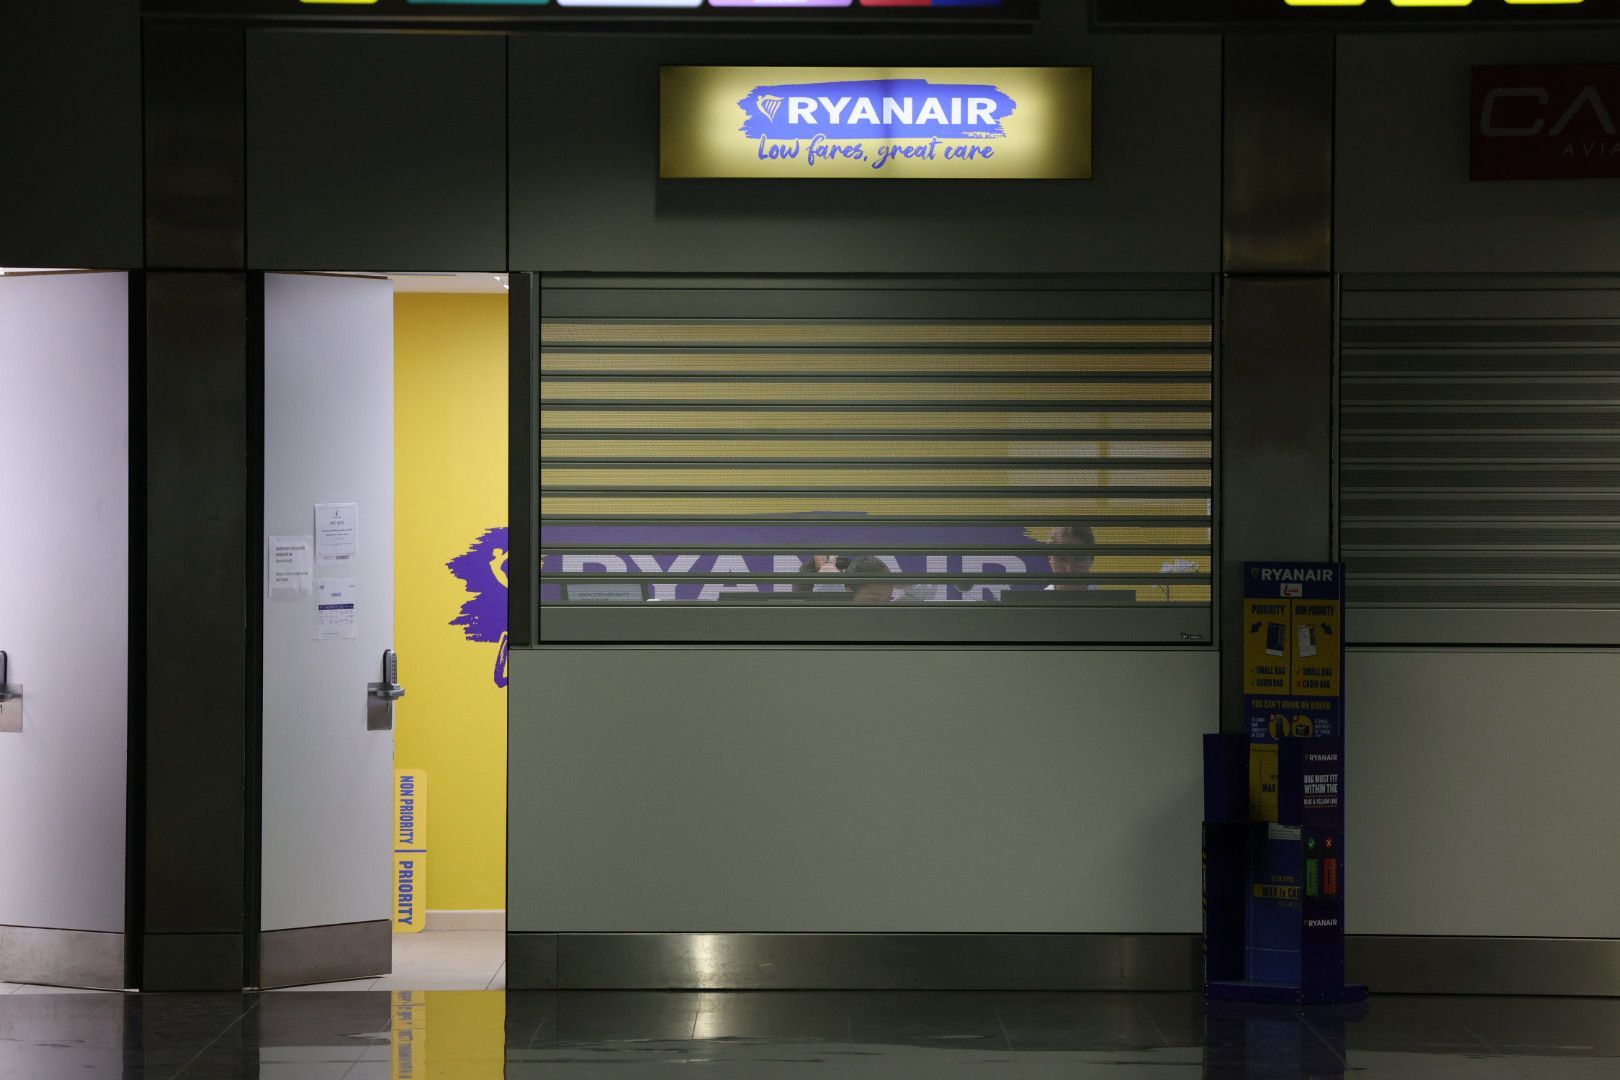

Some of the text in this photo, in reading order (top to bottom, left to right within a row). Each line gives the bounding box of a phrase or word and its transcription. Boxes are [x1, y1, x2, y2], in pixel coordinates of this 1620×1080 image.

[788, 96, 998, 125] RYANAIR
[757, 133, 995, 170] Low fares, great care
[1261, 568, 1334, 582] RYANAIR
[1251, 604, 1285, 615] PRIORITY
[1309, 753, 1338, 762] RYANAIR
[1314, 774, 1329, 783] MUST
[1262, 783, 1276, 793] MAX
[1303, 783, 1338, 794] WITHIN THE
[399, 775, 415, 846] NON PRIORITY
[397, 860, 414, 926] PRIORITY
[1262, 886, 1278, 897] MAX
[1308, 919, 1338, 927] RYANAIR
